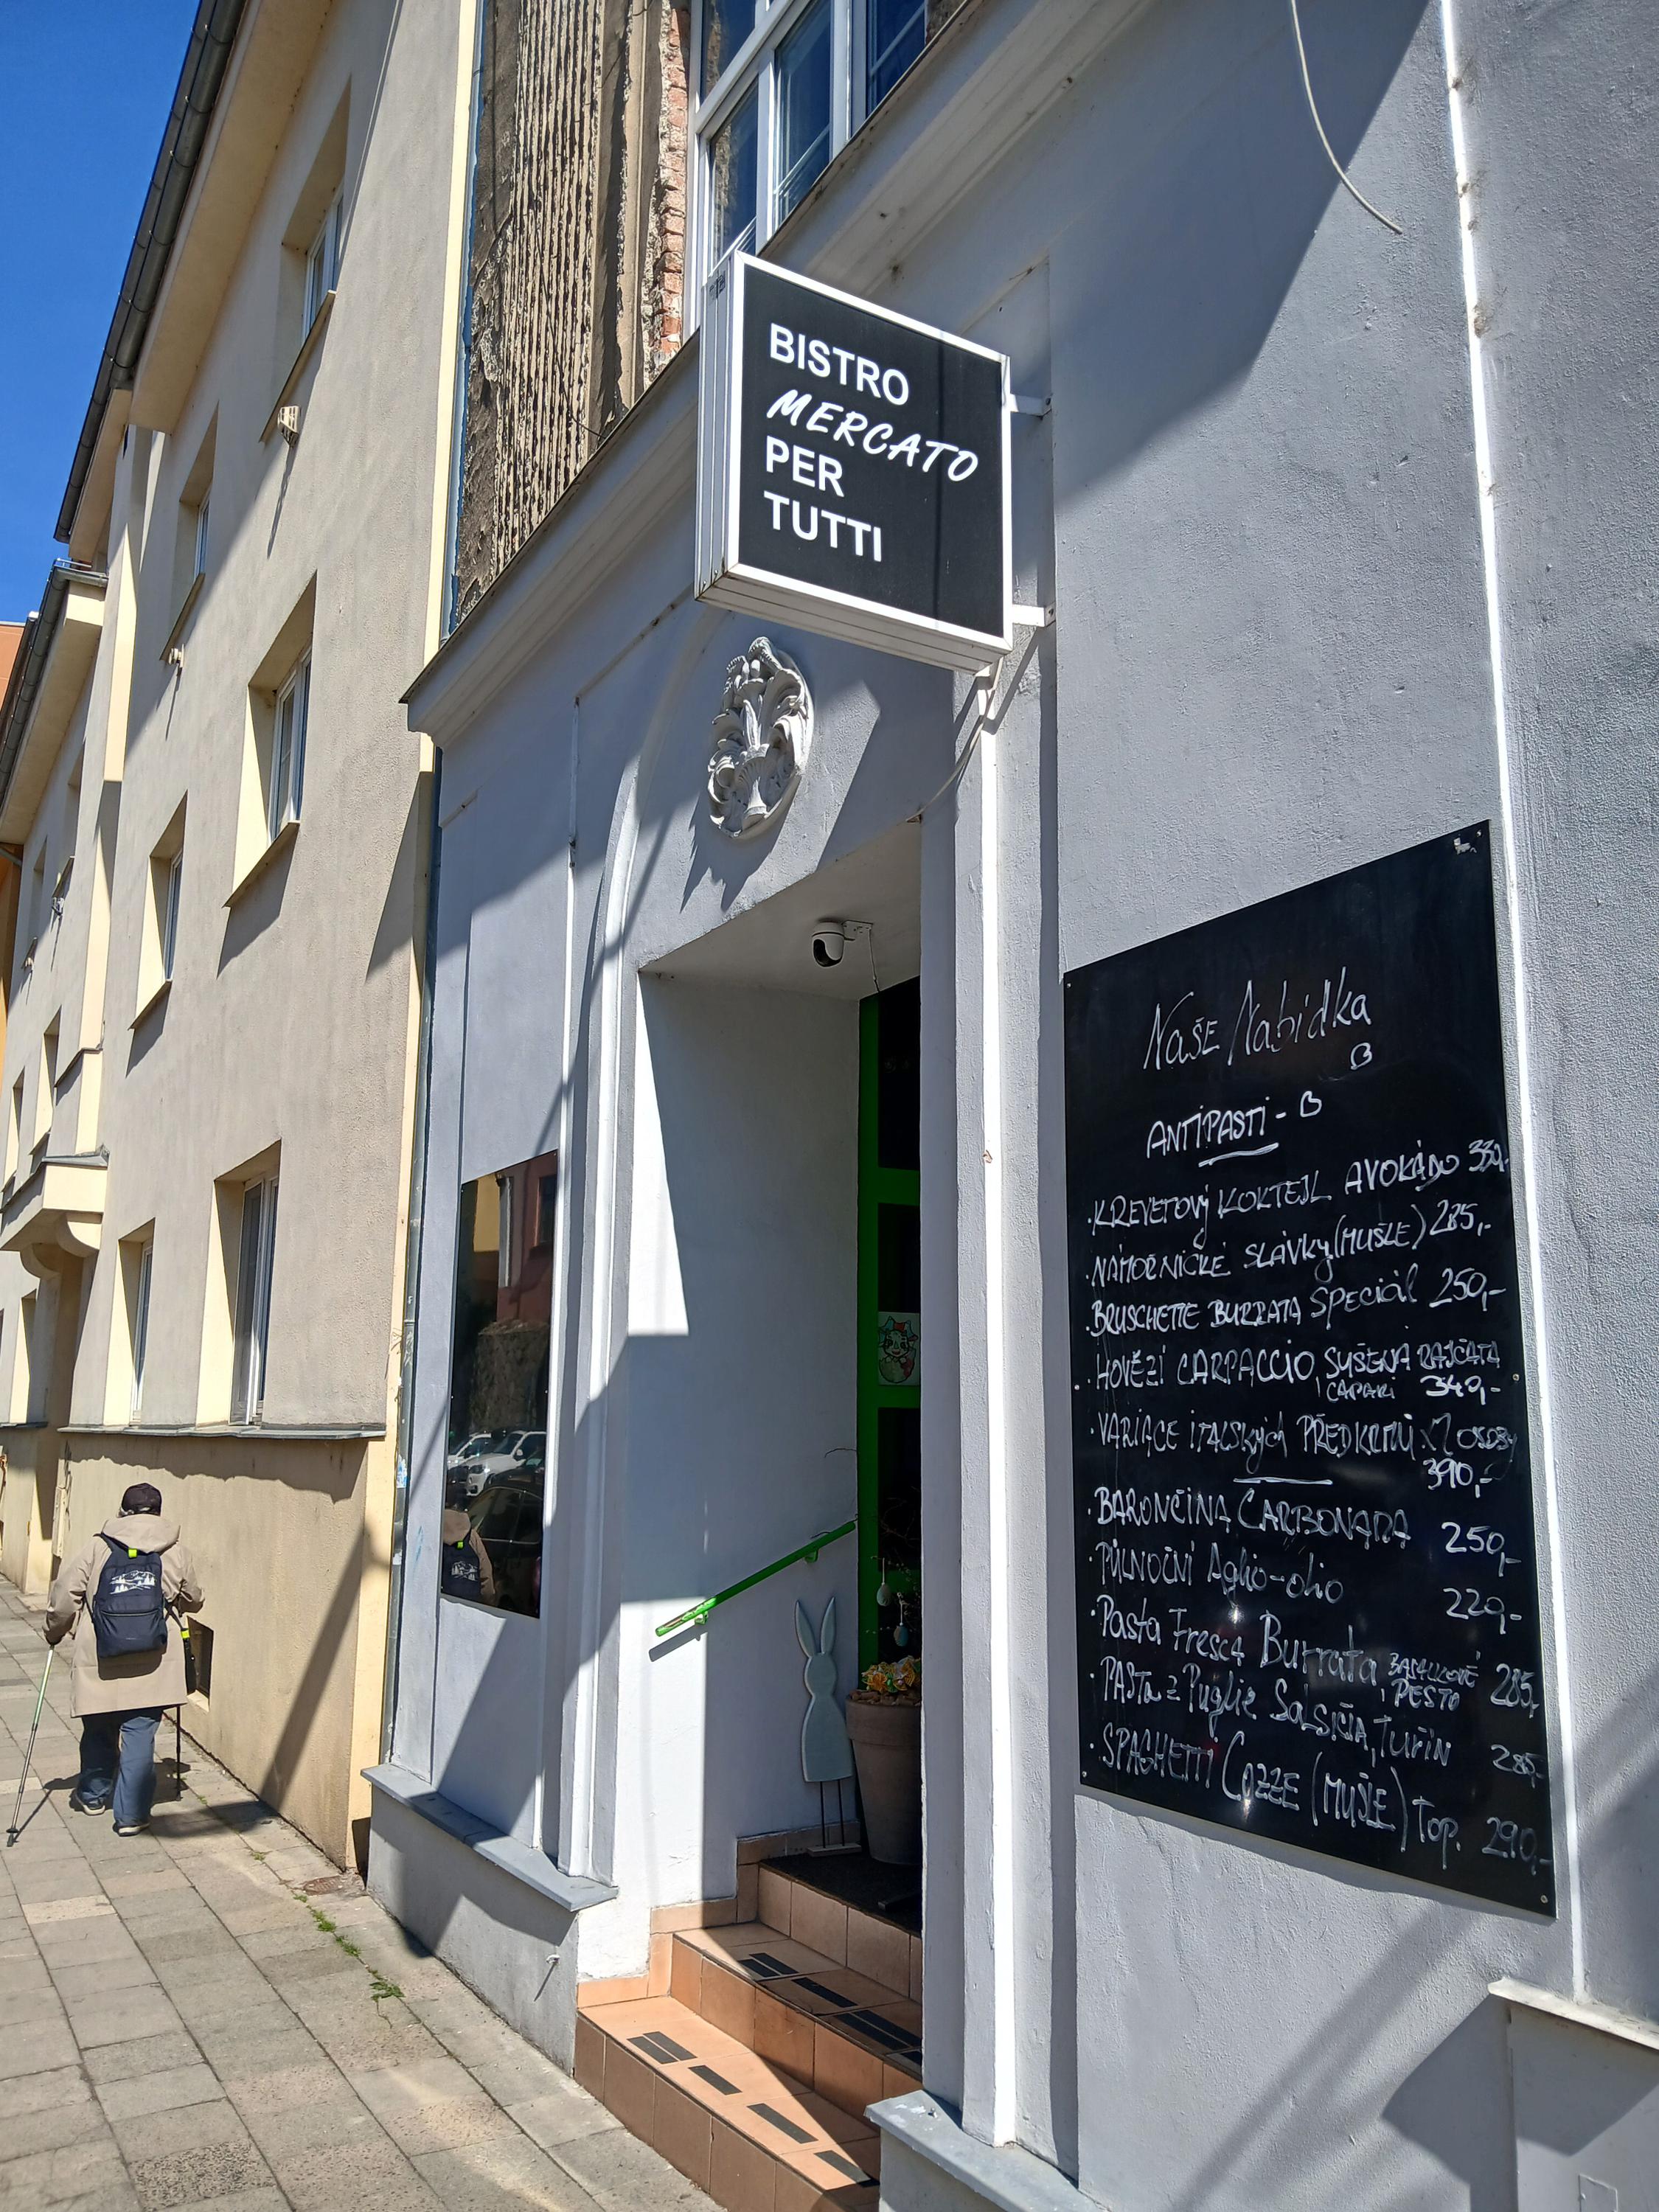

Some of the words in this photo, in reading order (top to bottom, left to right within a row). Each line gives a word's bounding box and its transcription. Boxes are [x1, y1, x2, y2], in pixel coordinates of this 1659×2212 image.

[769, 322, 910, 406] BISTRO
[766, 389, 979, 481] MERCATO
[765, 435, 845, 497] PER
[764, 490, 882, 563] TUTTI
[1429, 1267, 1506, 1312] 250,-
[1441, 1522, 1522, 1577] 250,-
[1096, 1594, 1161, 1646] Pasta
[1443, 1587, 1522, 1635] 220,-
